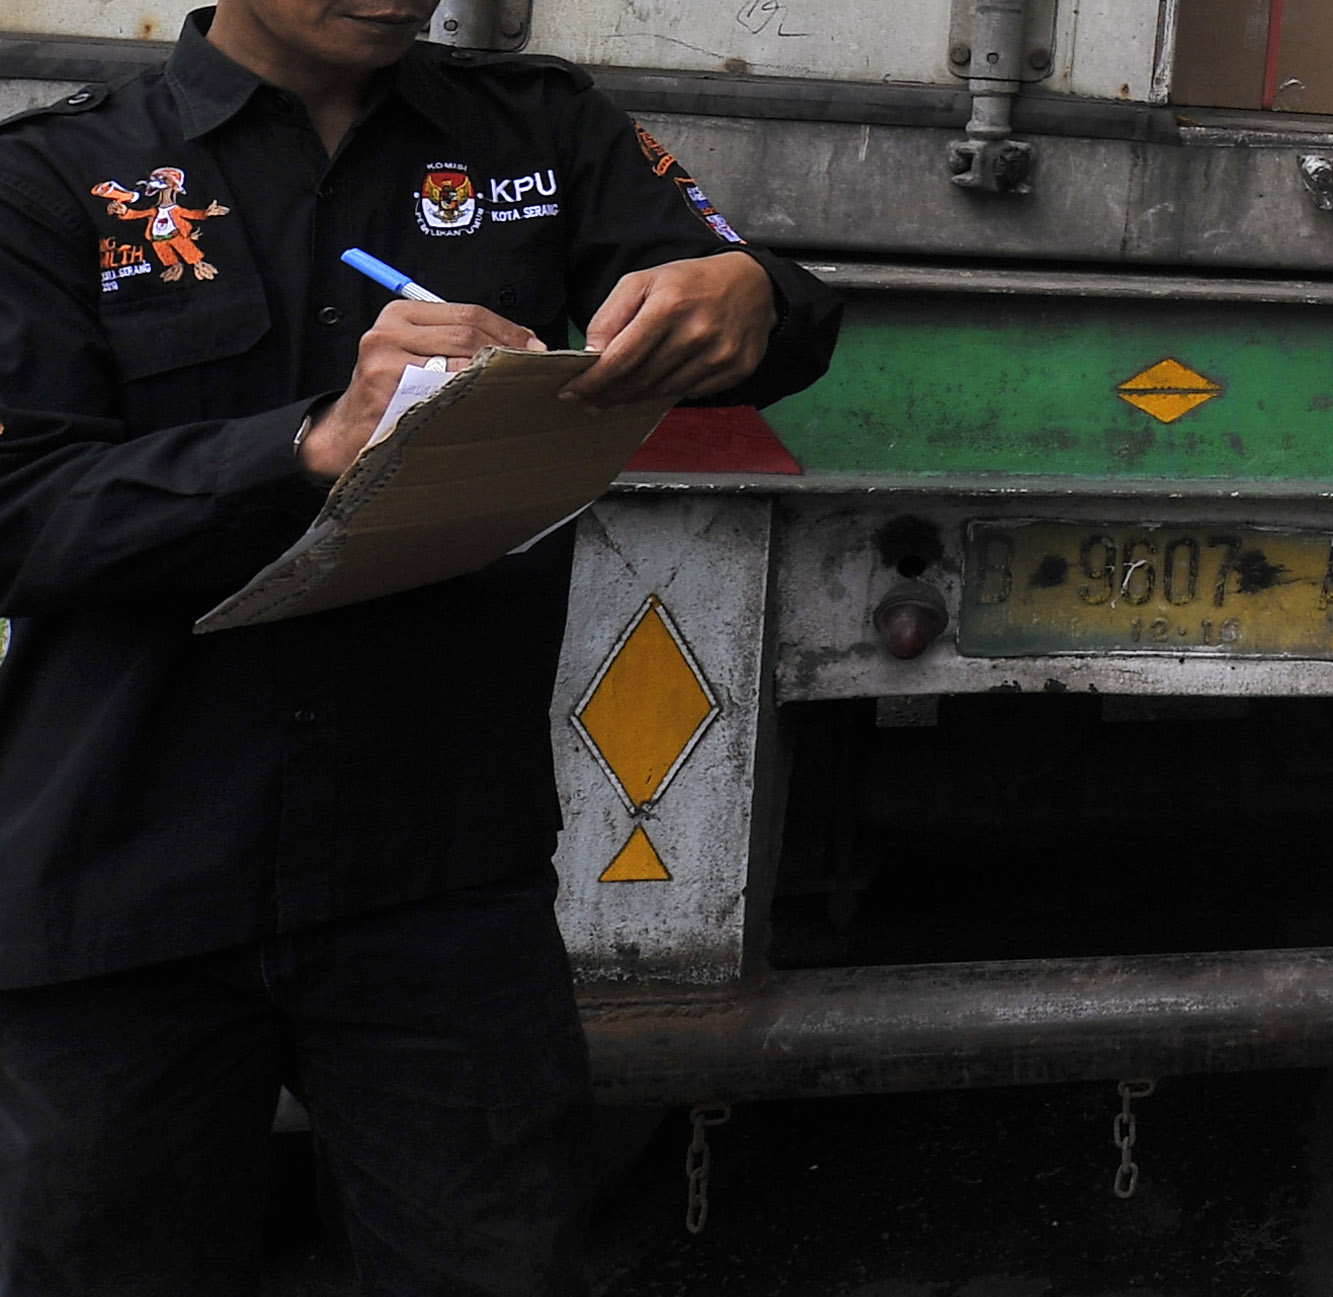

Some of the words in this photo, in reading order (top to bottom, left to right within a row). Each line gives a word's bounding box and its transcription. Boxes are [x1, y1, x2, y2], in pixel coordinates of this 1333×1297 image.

[490, 169, 558, 204] KPU
[491, 210, 522, 222] KOTA
[1077, 533, 1242, 608] 9607
